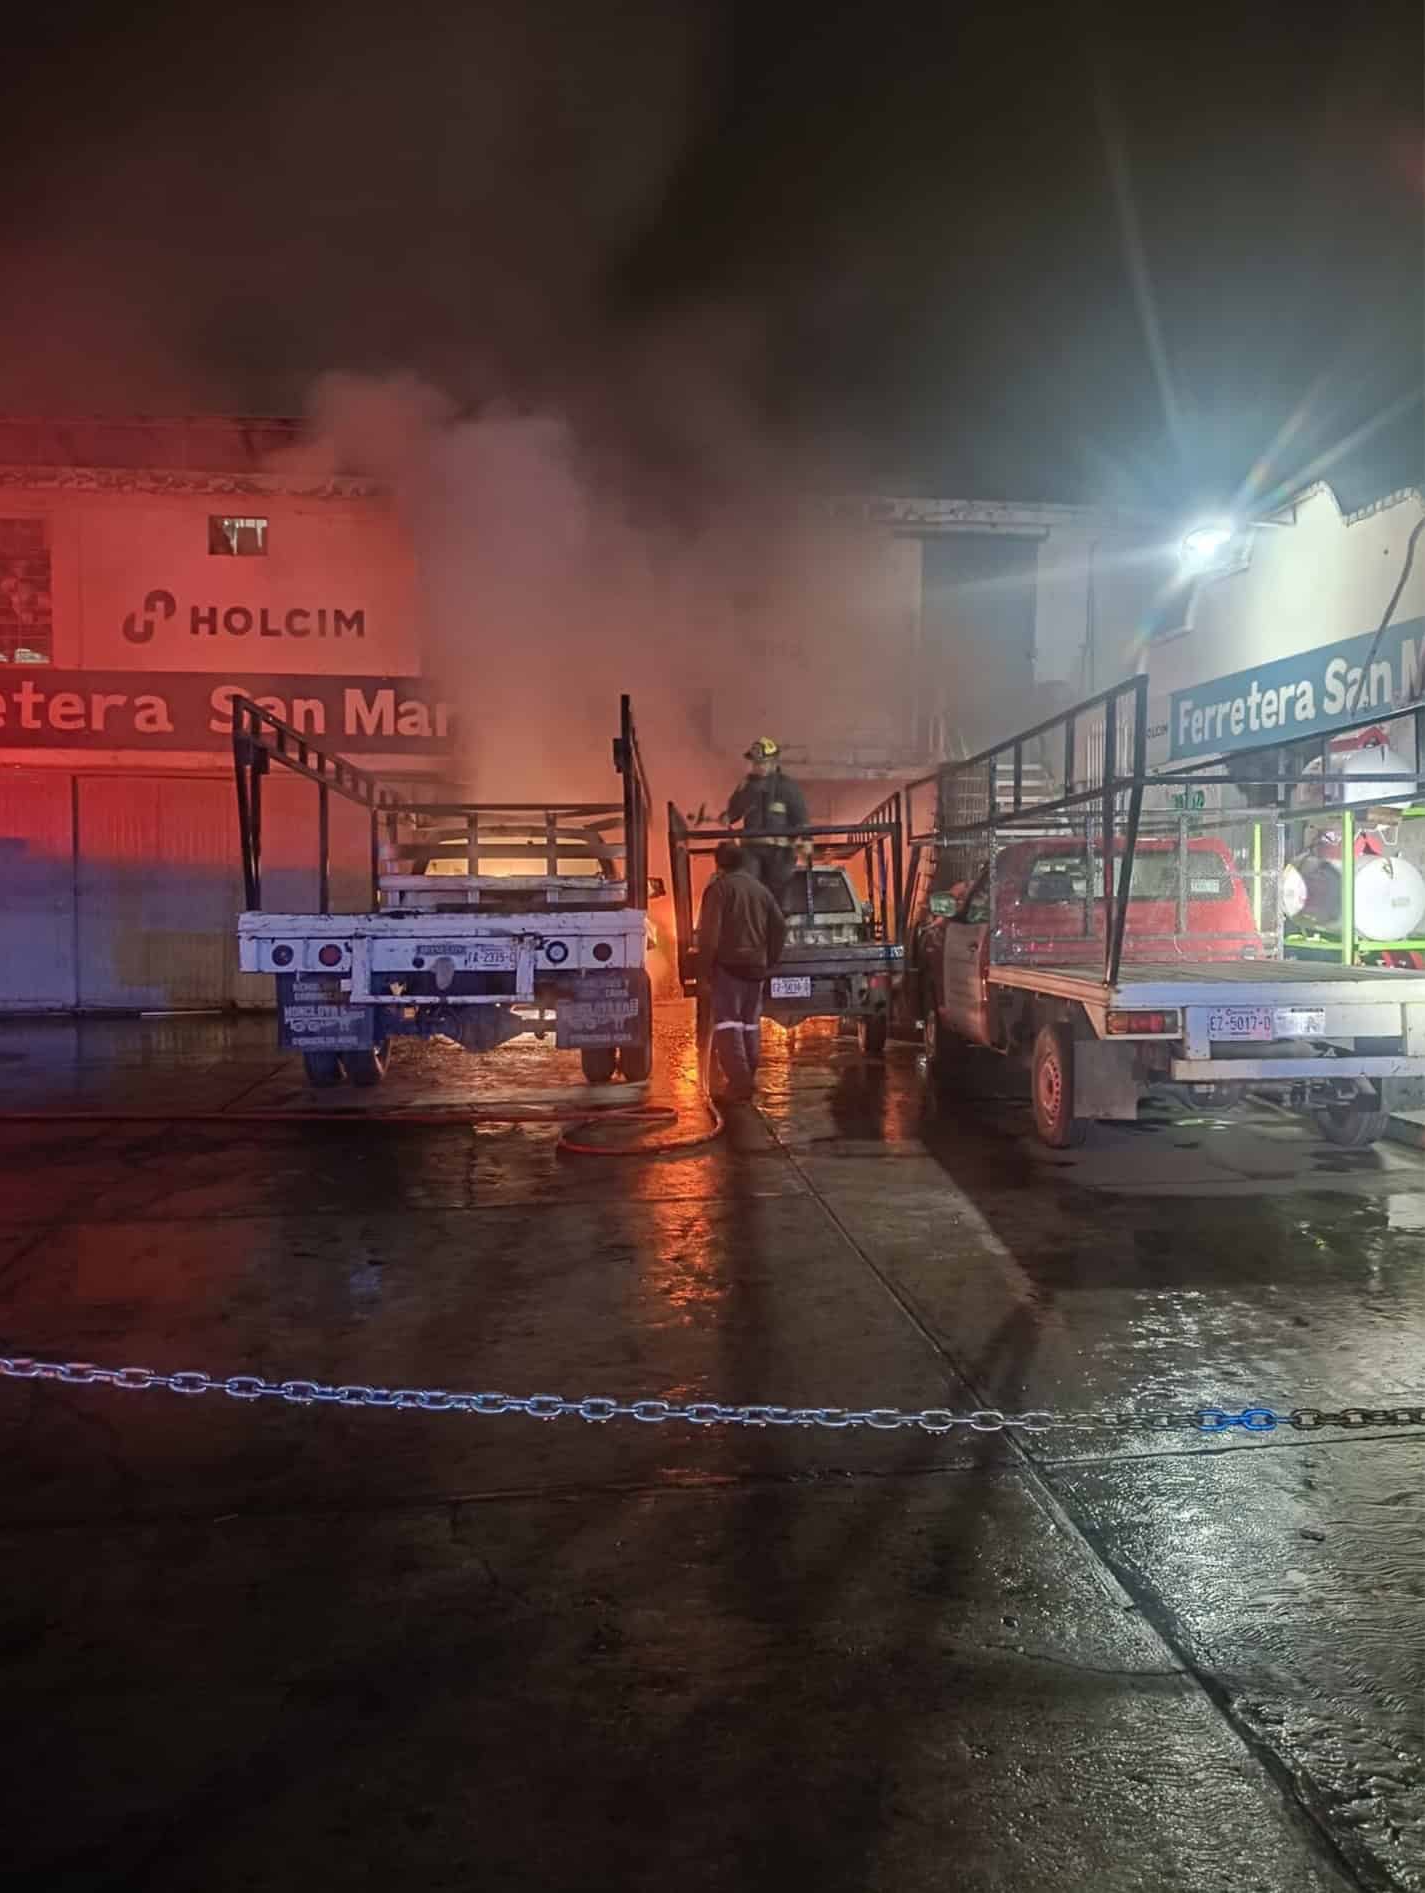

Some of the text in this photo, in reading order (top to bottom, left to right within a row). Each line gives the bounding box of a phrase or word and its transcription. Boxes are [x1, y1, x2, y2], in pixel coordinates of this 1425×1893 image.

[189, 605, 365, 638] HOLCIM
[1178, 678, 1316, 745] Ferretera
[1323, 657, 1392, 715] San
